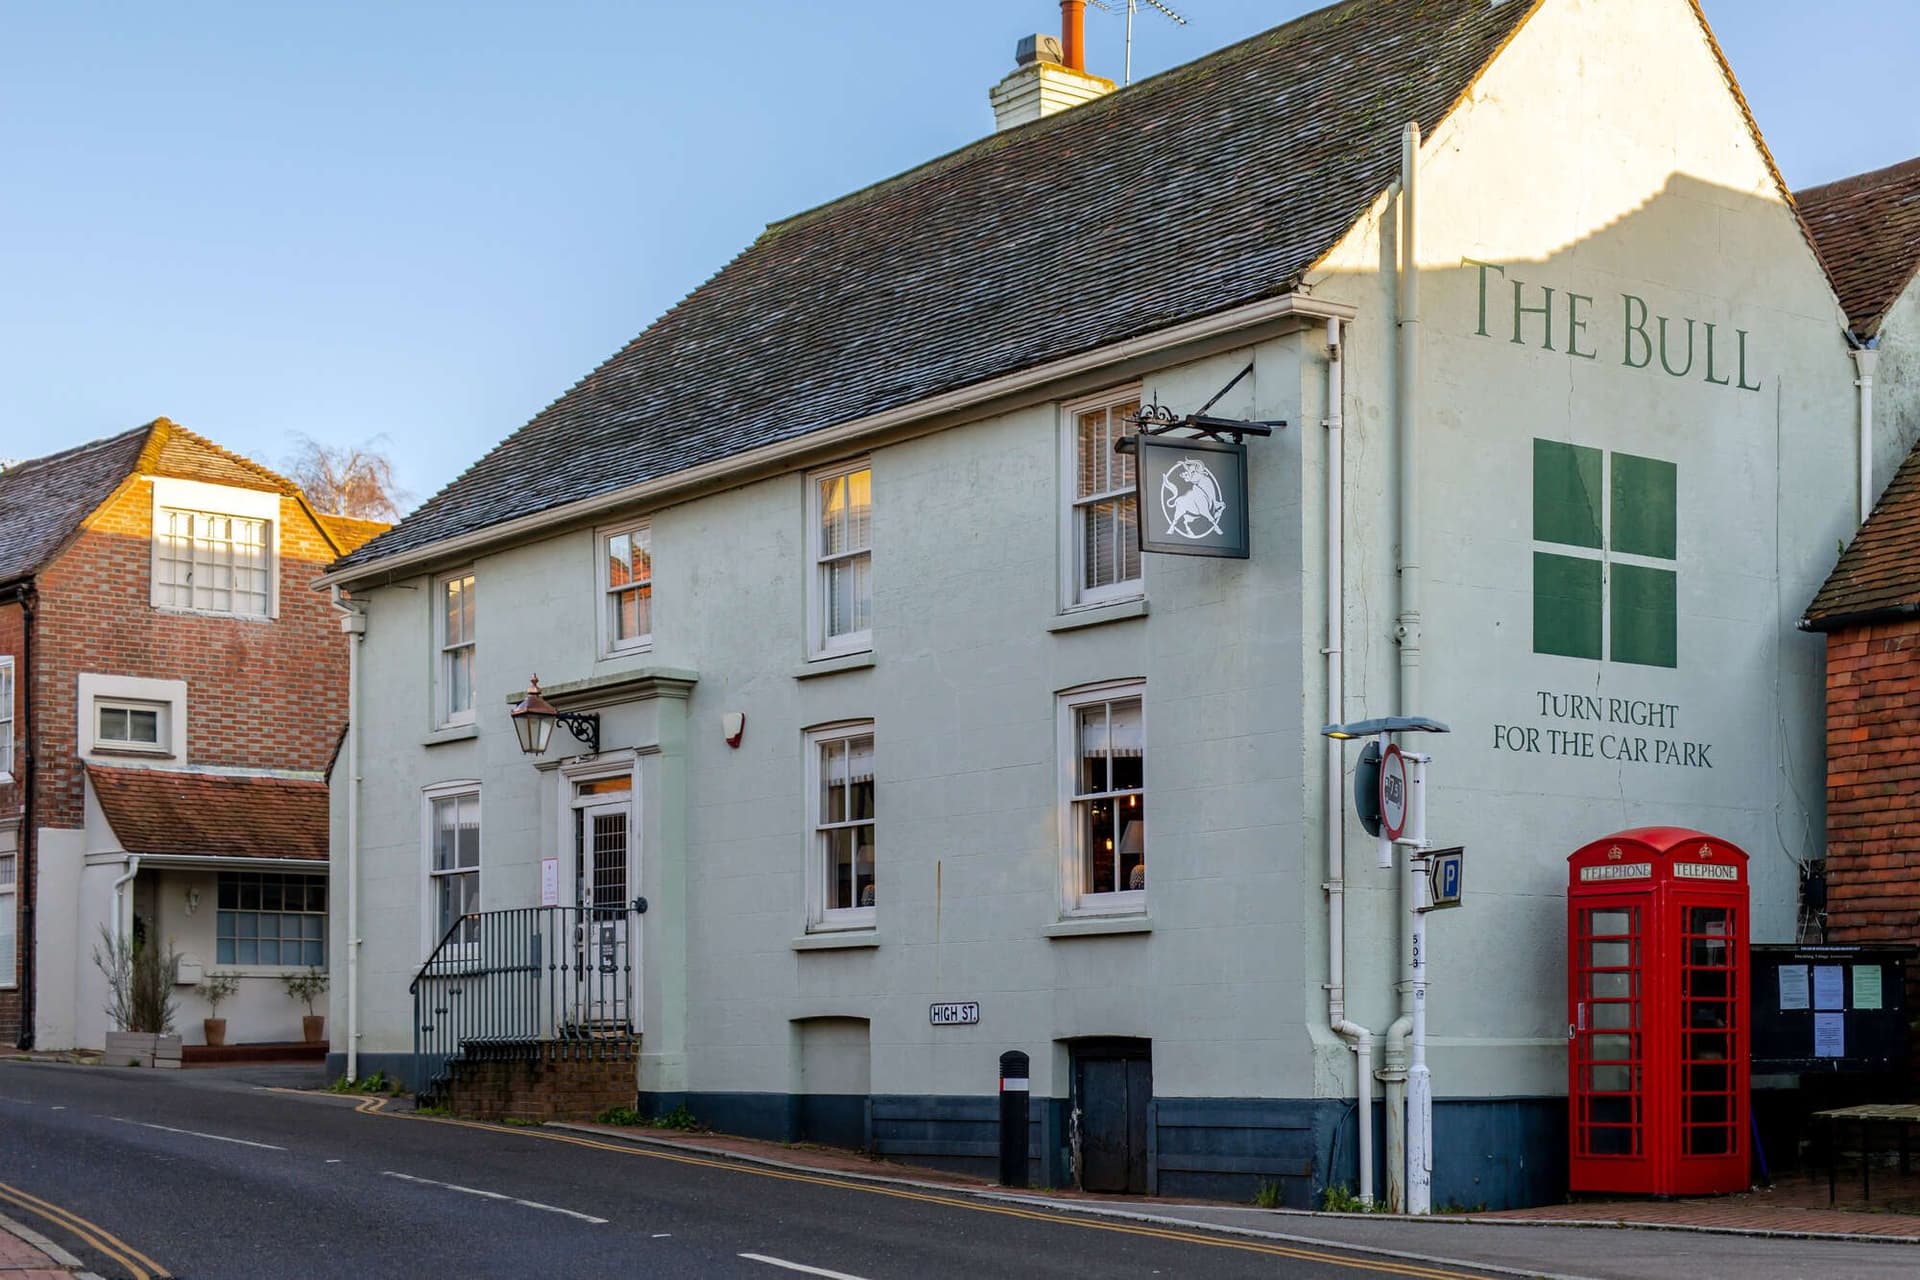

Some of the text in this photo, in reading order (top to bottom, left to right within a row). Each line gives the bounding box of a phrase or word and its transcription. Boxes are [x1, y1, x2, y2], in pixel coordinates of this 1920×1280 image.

[1460, 255, 1762, 392] THE BULL
[1537, 691, 1680, 729] TURN RIGHT
[1493, 724, 1713, 769] FOR THE CAR PARK
[1446, 864, 1456, 891] P
[1584, 866, 1650, 880] TELEPHONE
[1676, 863, 1735, 879] TELEPHONE
[933, 1005, 976, 1022] HIGH ST.
